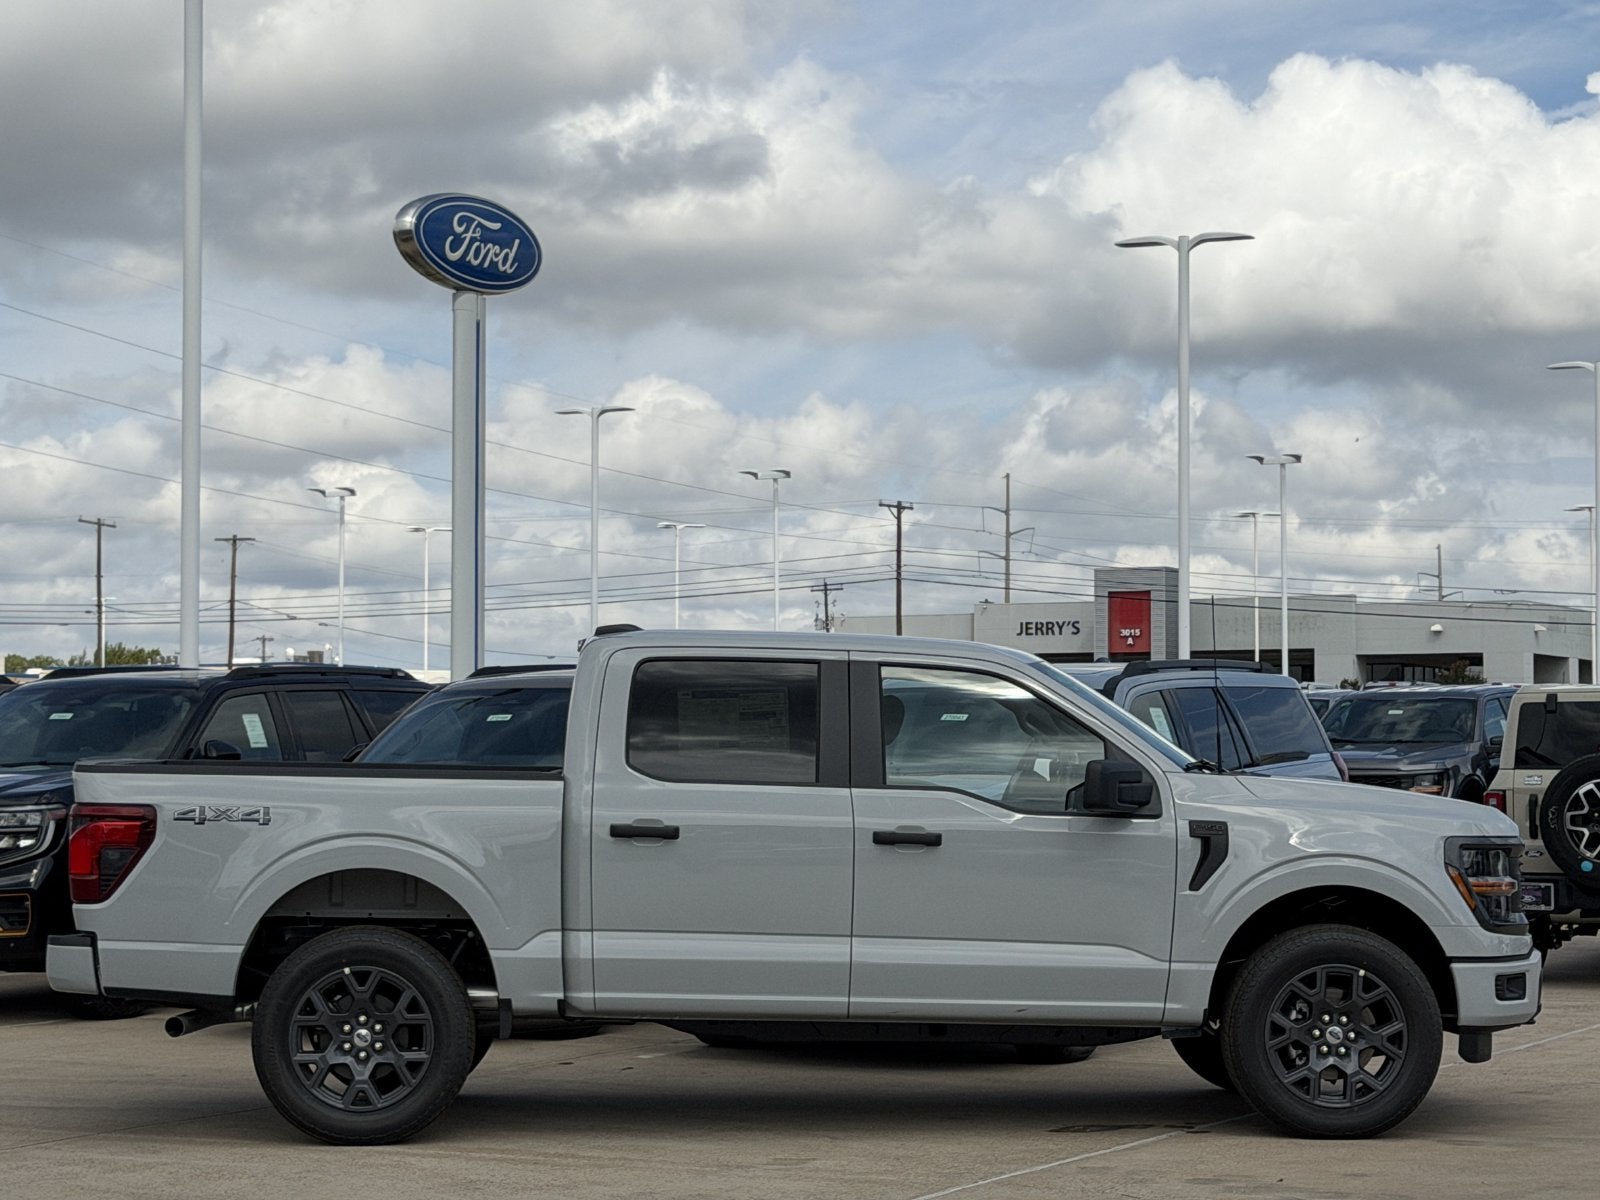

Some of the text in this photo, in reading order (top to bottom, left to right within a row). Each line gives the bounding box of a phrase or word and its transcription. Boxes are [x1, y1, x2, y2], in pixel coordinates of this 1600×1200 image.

[445, 211, 520, 274] Ford
[1016, 620, 1081, 636] JERRY'S
[1119, 628, 1141, 637] 3015
[1126, 637, 1134, 645] A
